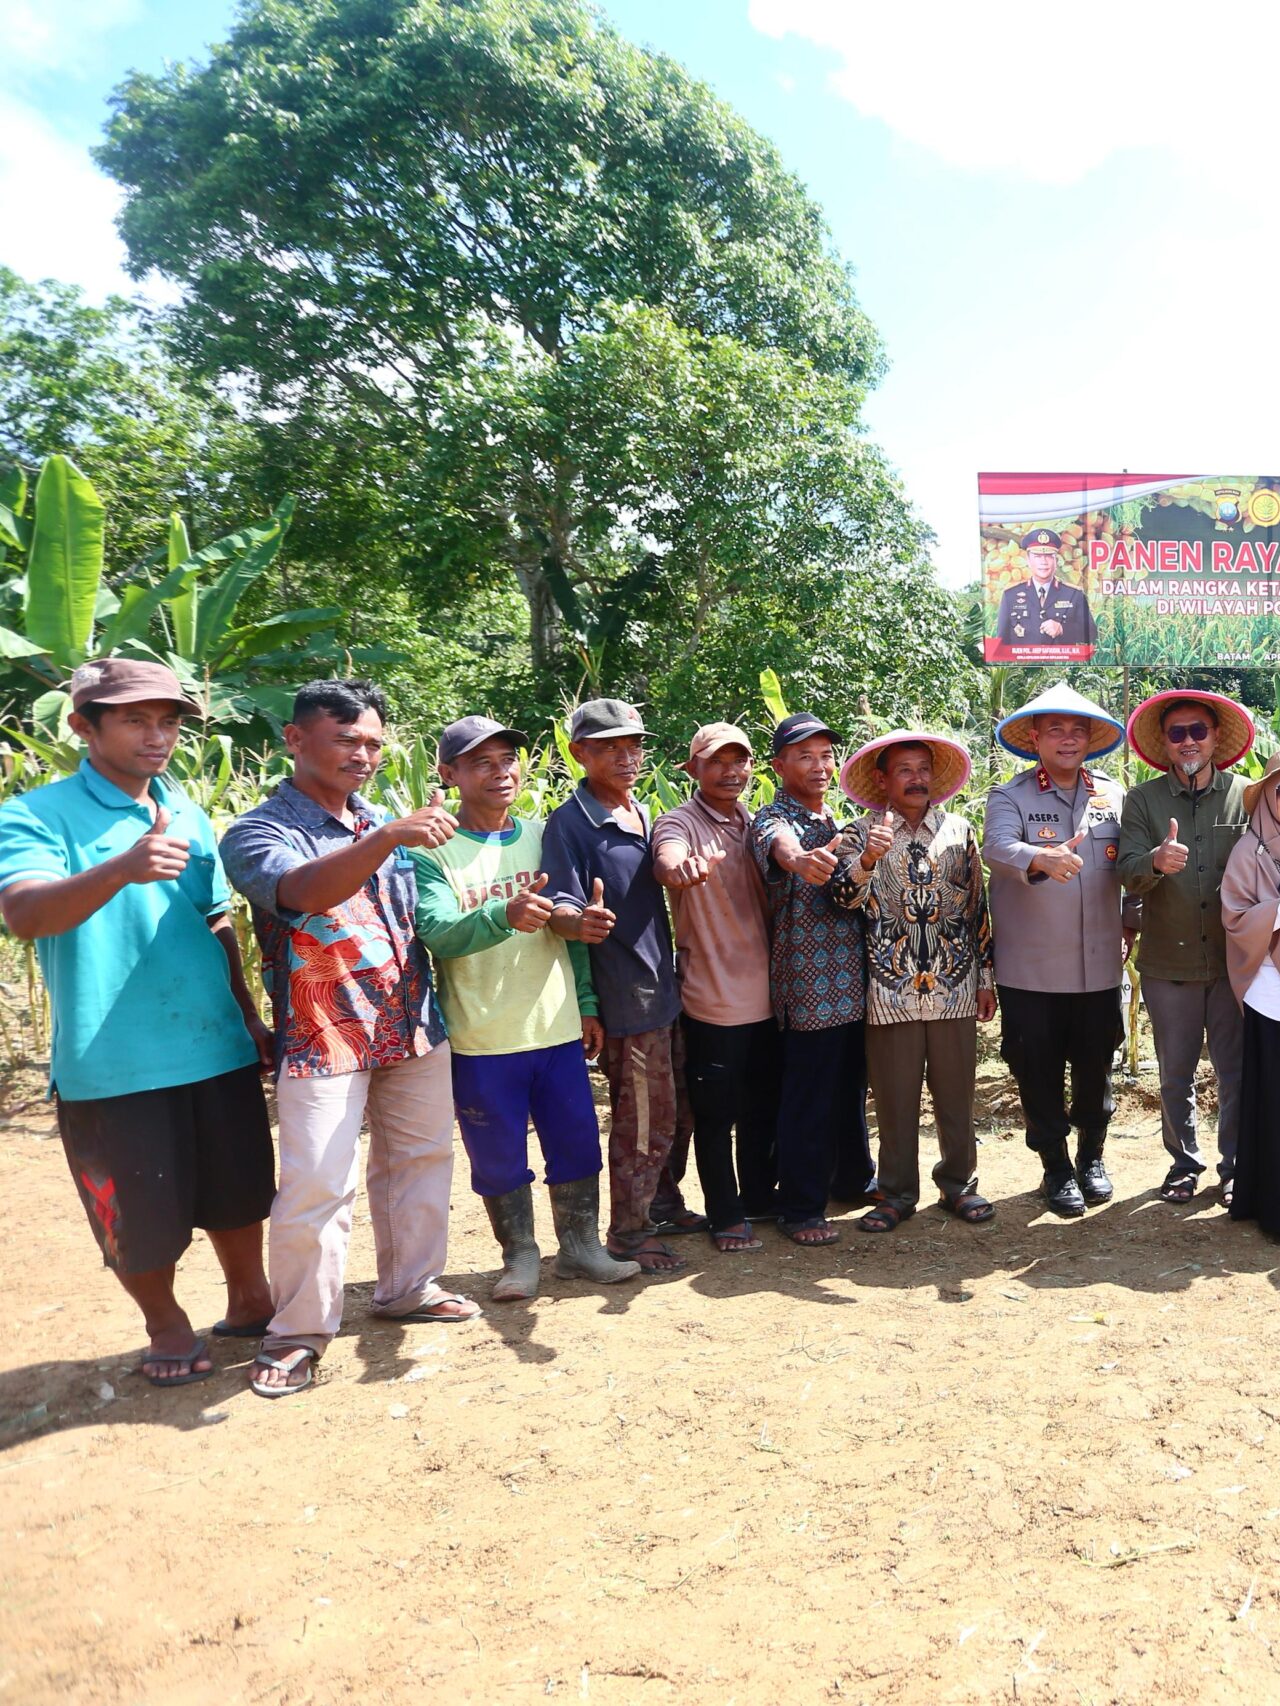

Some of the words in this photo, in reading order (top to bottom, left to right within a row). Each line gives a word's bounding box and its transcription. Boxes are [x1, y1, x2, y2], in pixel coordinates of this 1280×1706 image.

[1089, 540, 1202, 572] PANEN
[1102, 580, 1163, 595] DALAM
[1168, 581, 1241, 596] RANGKA
[1157, 600, 1175, 614] DI
[1178, 600, 1256, 615] WILAYAH
[1088, 812, 1118, 821] POLRI
